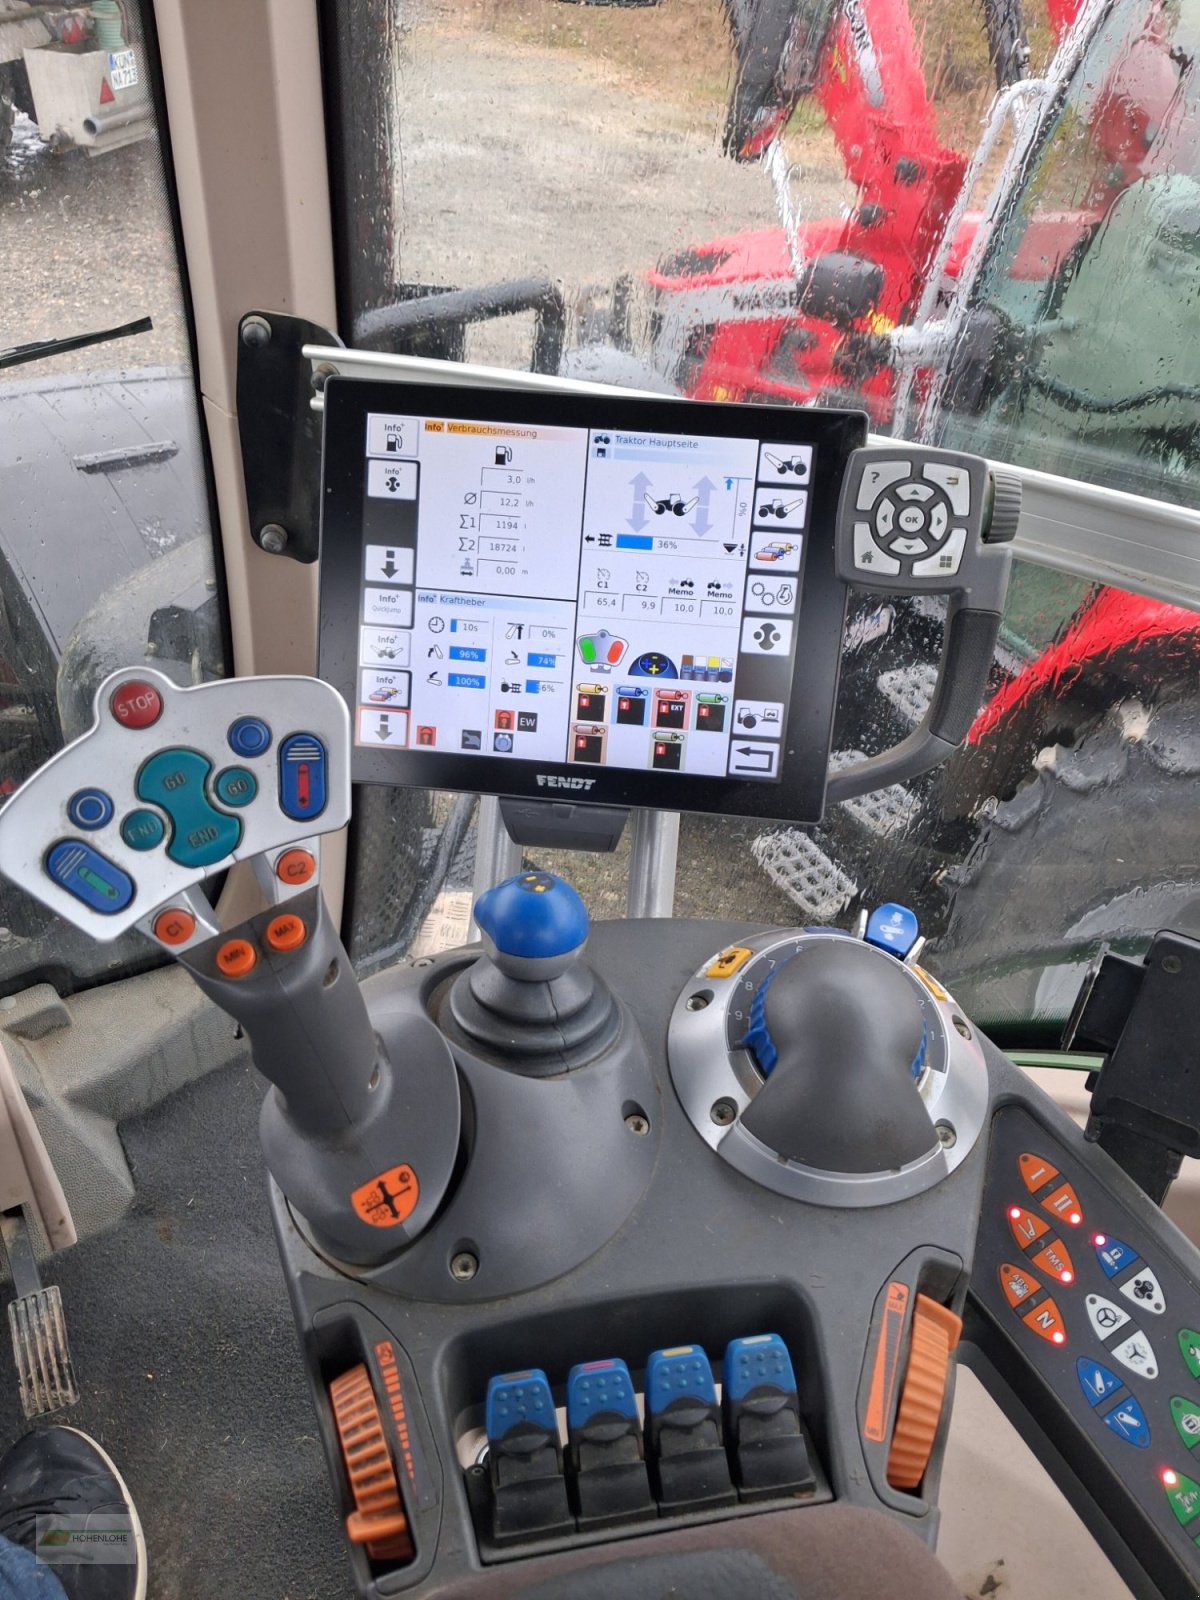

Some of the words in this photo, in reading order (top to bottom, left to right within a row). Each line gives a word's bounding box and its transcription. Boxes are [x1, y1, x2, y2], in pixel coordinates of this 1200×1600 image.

[447, 422, 538, 438] Verbrauchsmessung
[615, 435, 646, 446] Traktor
[649, 437, 699, 450] Hauptseite
[507, 476, 522, 484] 3,0
[500, 498, 519, 508] 12,2
[905, 516, 918, 524] OK
[496, 521, 518, 530] 1194
[490, 543, 517, 552] 18724
[657, 540, 678, 550] 36%
[496, 567, 516, 576] 0,00
[597, 580, 609, 588] C1
[636, 584, 648, 592] C2
[668, 588, 694, 596] Memo
[707, 590, 733, 599] Memo
[440, 596, 486, 606] Kraftheber
[596, 598, 616, 607] 65,4
[642, 601, 656, 610] 9,9
[674, 604, 694, 614] 10,0
[714, 606, 733, 616] 10,0
[463, 624, 478, 632] 10s
[542, 630, 556, 638] 0%
[459, 650, 478, 660] 96%
[456, 677, 480, 686] 100%
[117, 691, 156, 718] STOP
[520, 718, 536, 728] EW
[164, 772, 186, 789] GO
[536, 774, 596, 790] FENDT
[227, 780, 247, 796] GO
[188, 826, 218, 848] END
[286, 862, 307, 877] C2
[166, 922, 184, 937] C1
[274, 922, 295, 938] MAX
[768, 960, 776, 968] 7
[744, 982, 754, 990] 8
[734, 1011, 743, 1020] 9
[1046, 1248, 1064, 1272] TMS
[1036, 1310, 1056, 1329] N
